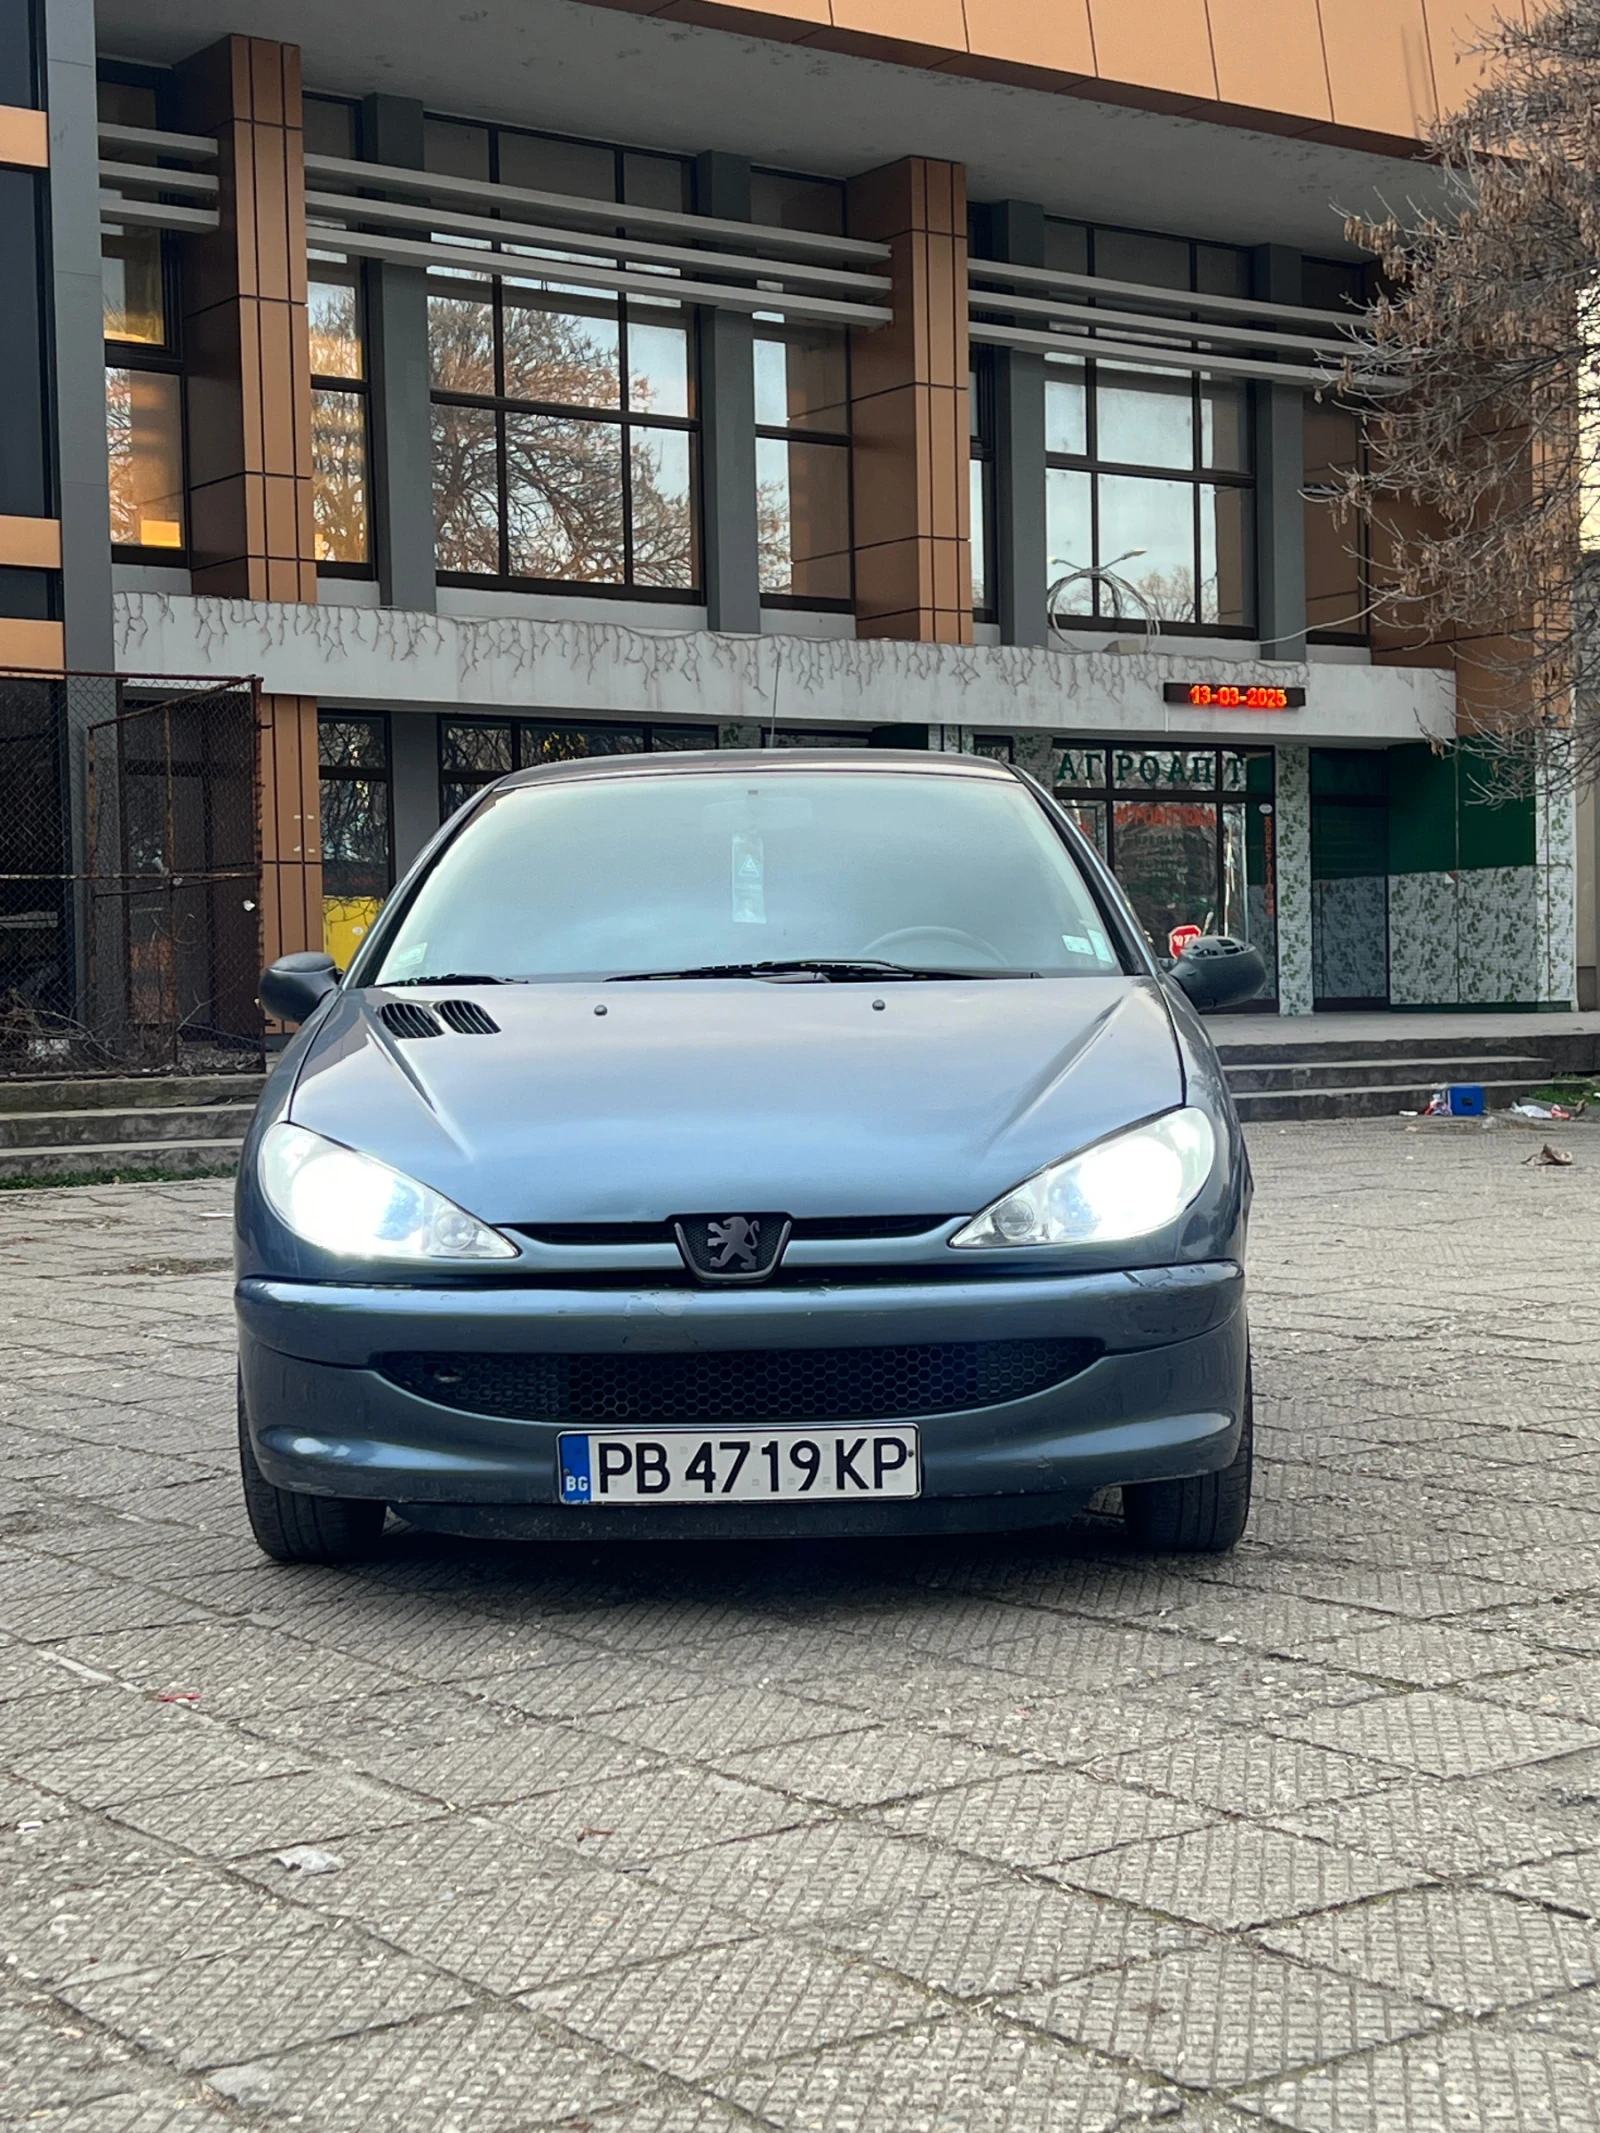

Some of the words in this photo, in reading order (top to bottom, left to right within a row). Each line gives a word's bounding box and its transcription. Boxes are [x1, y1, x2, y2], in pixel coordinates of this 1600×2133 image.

[1190, 685, 1287, 708] 13-03-2025
[599, 1442, 671, 1494] PB
[684, 1439, 821, 1493] 4719
[835, 1436, 908, 1490] KP
[565, 1475, 588, 1492] BG
